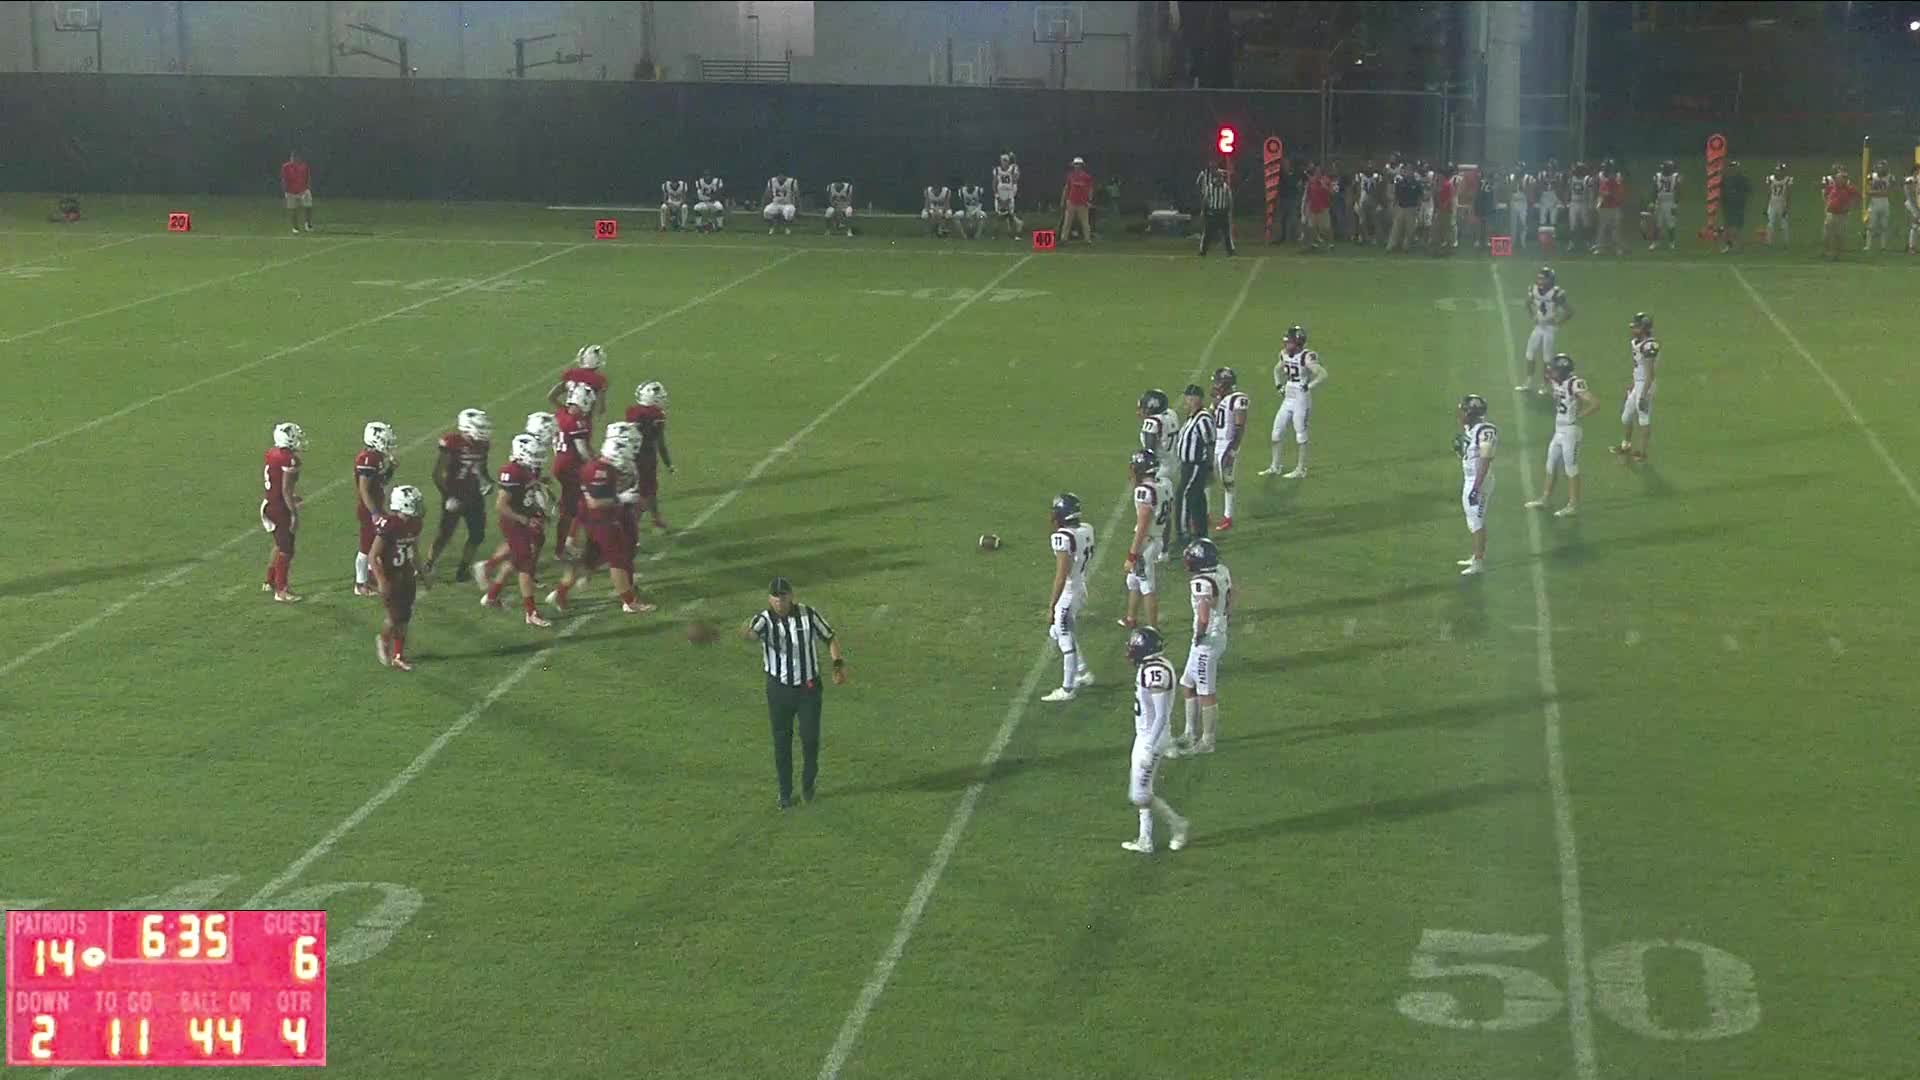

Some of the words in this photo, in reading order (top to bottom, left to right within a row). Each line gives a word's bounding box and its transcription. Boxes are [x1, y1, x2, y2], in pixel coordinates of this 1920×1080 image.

[1219, 128, 1234, 152] 2
[171, 215, 187, 228] 20
[598, 221, 615, 235] 30
[1035, 232, 1052, 247] 40
[1150, 670, 1162, 682] 15
[1394, 927, 1762, 1041] 50
